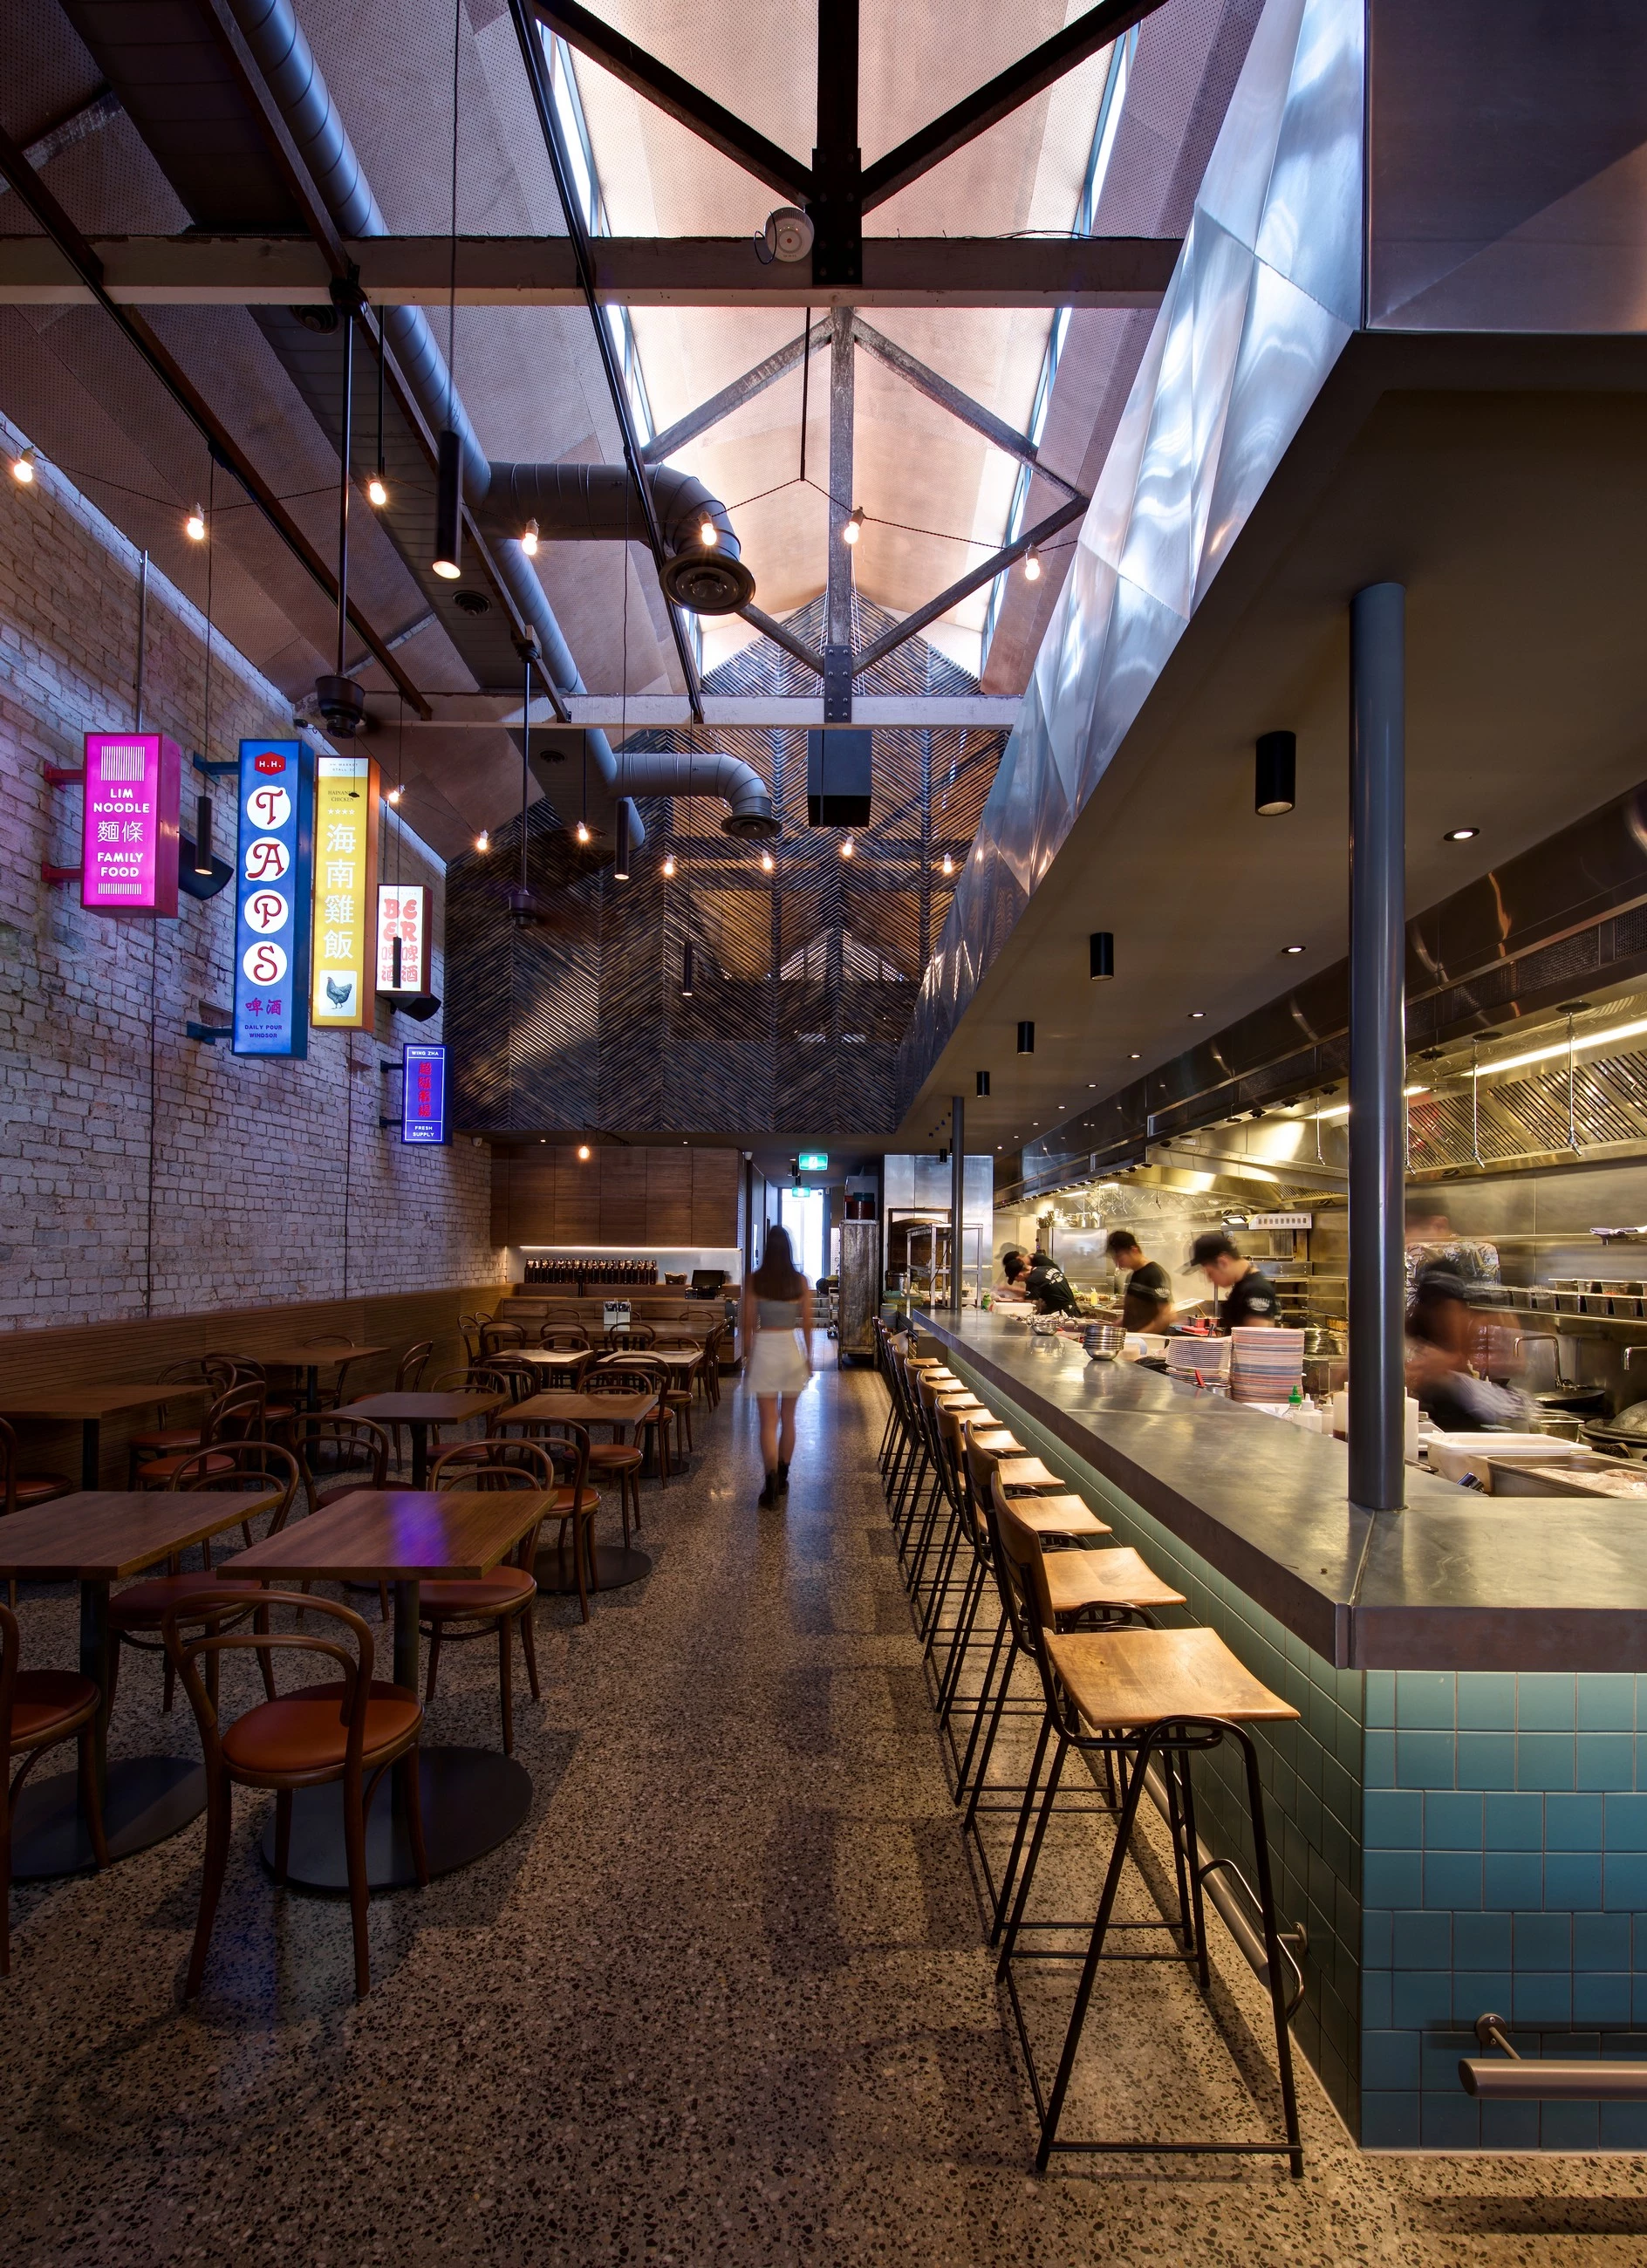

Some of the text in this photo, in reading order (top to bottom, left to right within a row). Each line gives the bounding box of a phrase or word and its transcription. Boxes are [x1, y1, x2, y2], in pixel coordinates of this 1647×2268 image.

[110, 788, 133, 798] LIM
[93, 803, 150, 813] NOODLE
[97, 821, 144, 843] 麵條
[97, 852, 144, 863] FAMILY
[100, 867, 140, 878] FOOD
[248, 789, 285, 982] TAPS
[324, 823, 356, 960] 海南雞飯
[245, 997, 282, 1017] 啤酒
